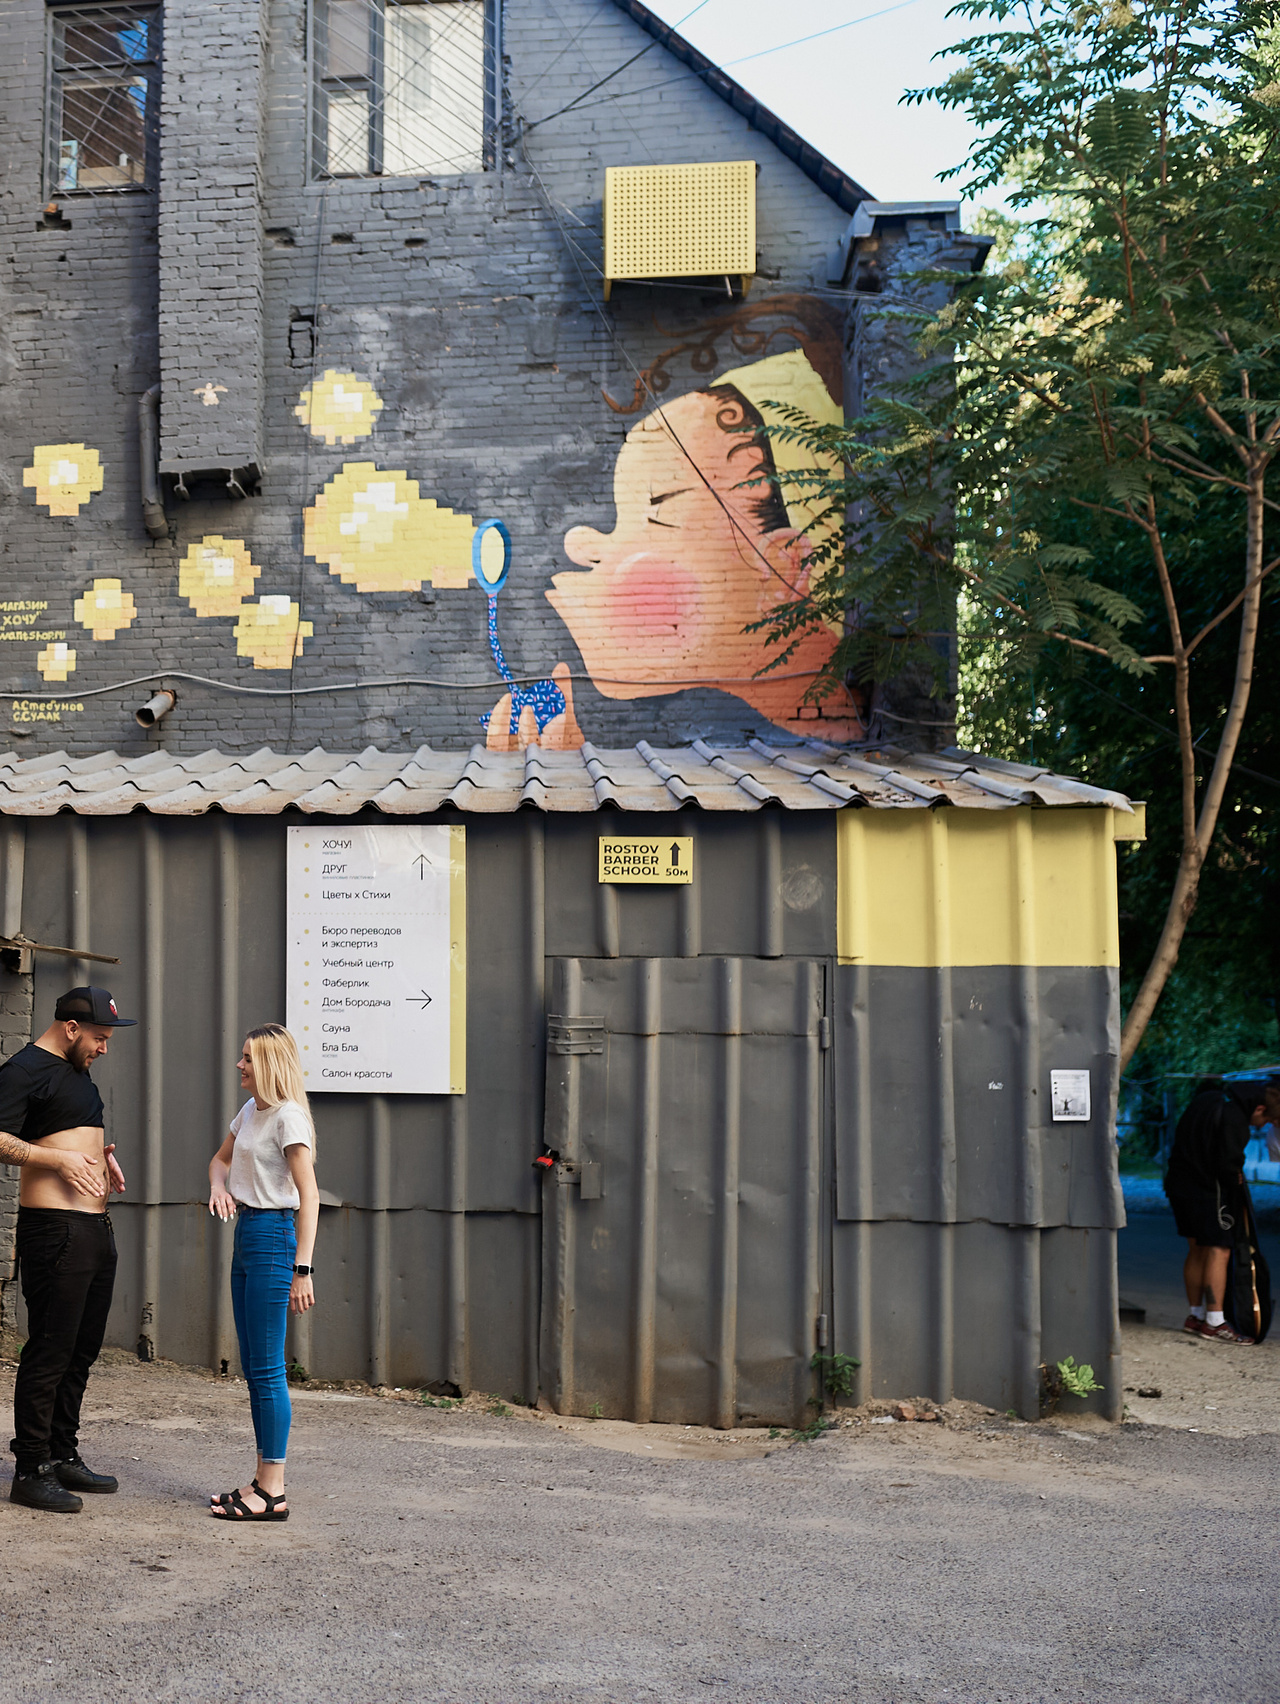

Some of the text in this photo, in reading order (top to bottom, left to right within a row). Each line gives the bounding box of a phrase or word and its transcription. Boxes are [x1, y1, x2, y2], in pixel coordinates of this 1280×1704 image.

[322, 839, 352, 849] ХОЧУ!
[603, 844, 659, 854] ROSTOV
[603, 855, 659, 865] BARBER
[322, 864, 348, 875] ДРУГ
[603, 866, 660, 876] SCHOOL
[322, 890, 352, 900] Цветы
[362, 890, 391, 899] Стихи
[322, 925, 402, 937] Бюро переводов
[330, 940, 378, 950] экспертиз
[322, 958, 394, 969] Учебный центр
[322, 978, 370, 989] Фаберлик
[322, 997, 391, 1008] Дом Бородача
[322, 1023, 351, 1035] Сауна
[322, 1042, 359, 1052] Бла Бла
[322, 1068, 393, 1080] Салон красоты
